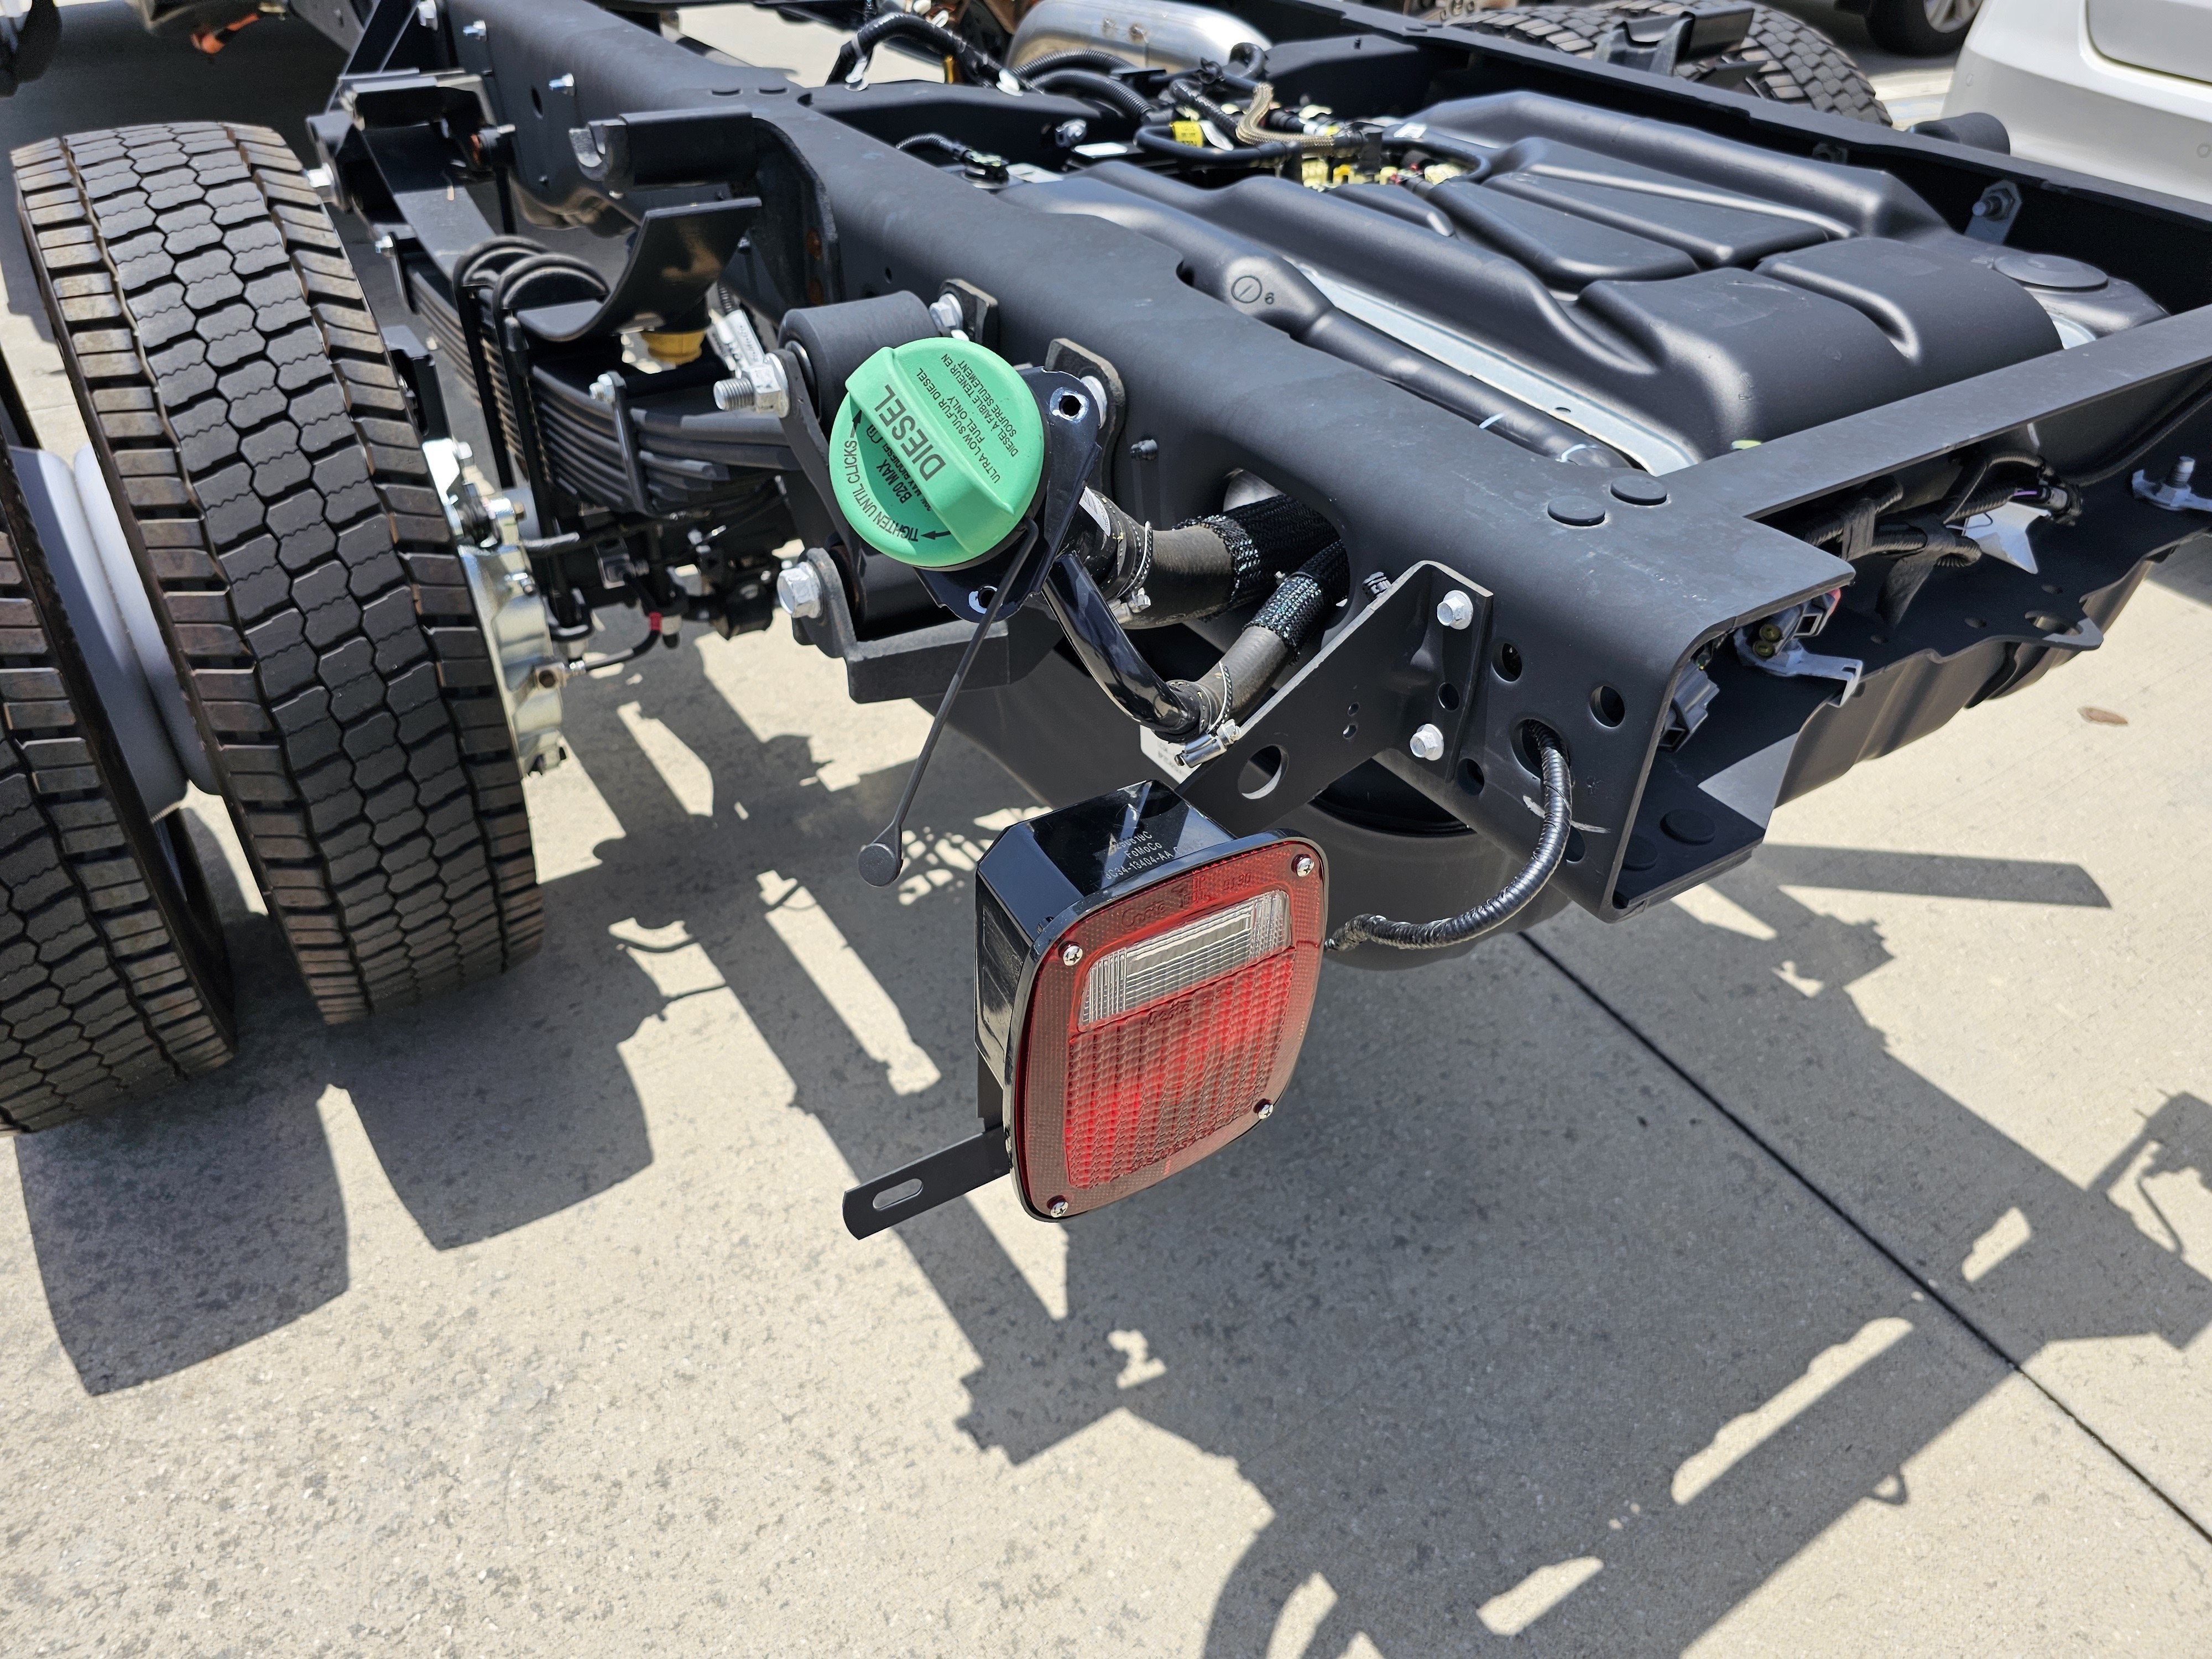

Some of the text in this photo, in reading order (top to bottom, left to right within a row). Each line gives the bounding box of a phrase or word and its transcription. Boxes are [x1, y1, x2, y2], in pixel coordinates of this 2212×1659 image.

[941, 353, 953, 367] EN
[950, 364, 974, 398] TENEUR
[947, 396, 985, 444] FUEL ONLY
[957, 360, 1016, 437] SOUFRE SEULEMENT
[972, 395, 995, 424] FAIBLE
[874, 384, 946, 481] DIESEL
[916, 368, 1000, 483] ULTRA LOW SULFUR DIESEL
[998, 427, 1019, 457] DIESEL
[844, 440, 919, 542] TIGHTEN UNTIL CLICKS
[876, 459, 912, 504] B20 MAX
[1124, 842, 1162, 858] FoMoCo
